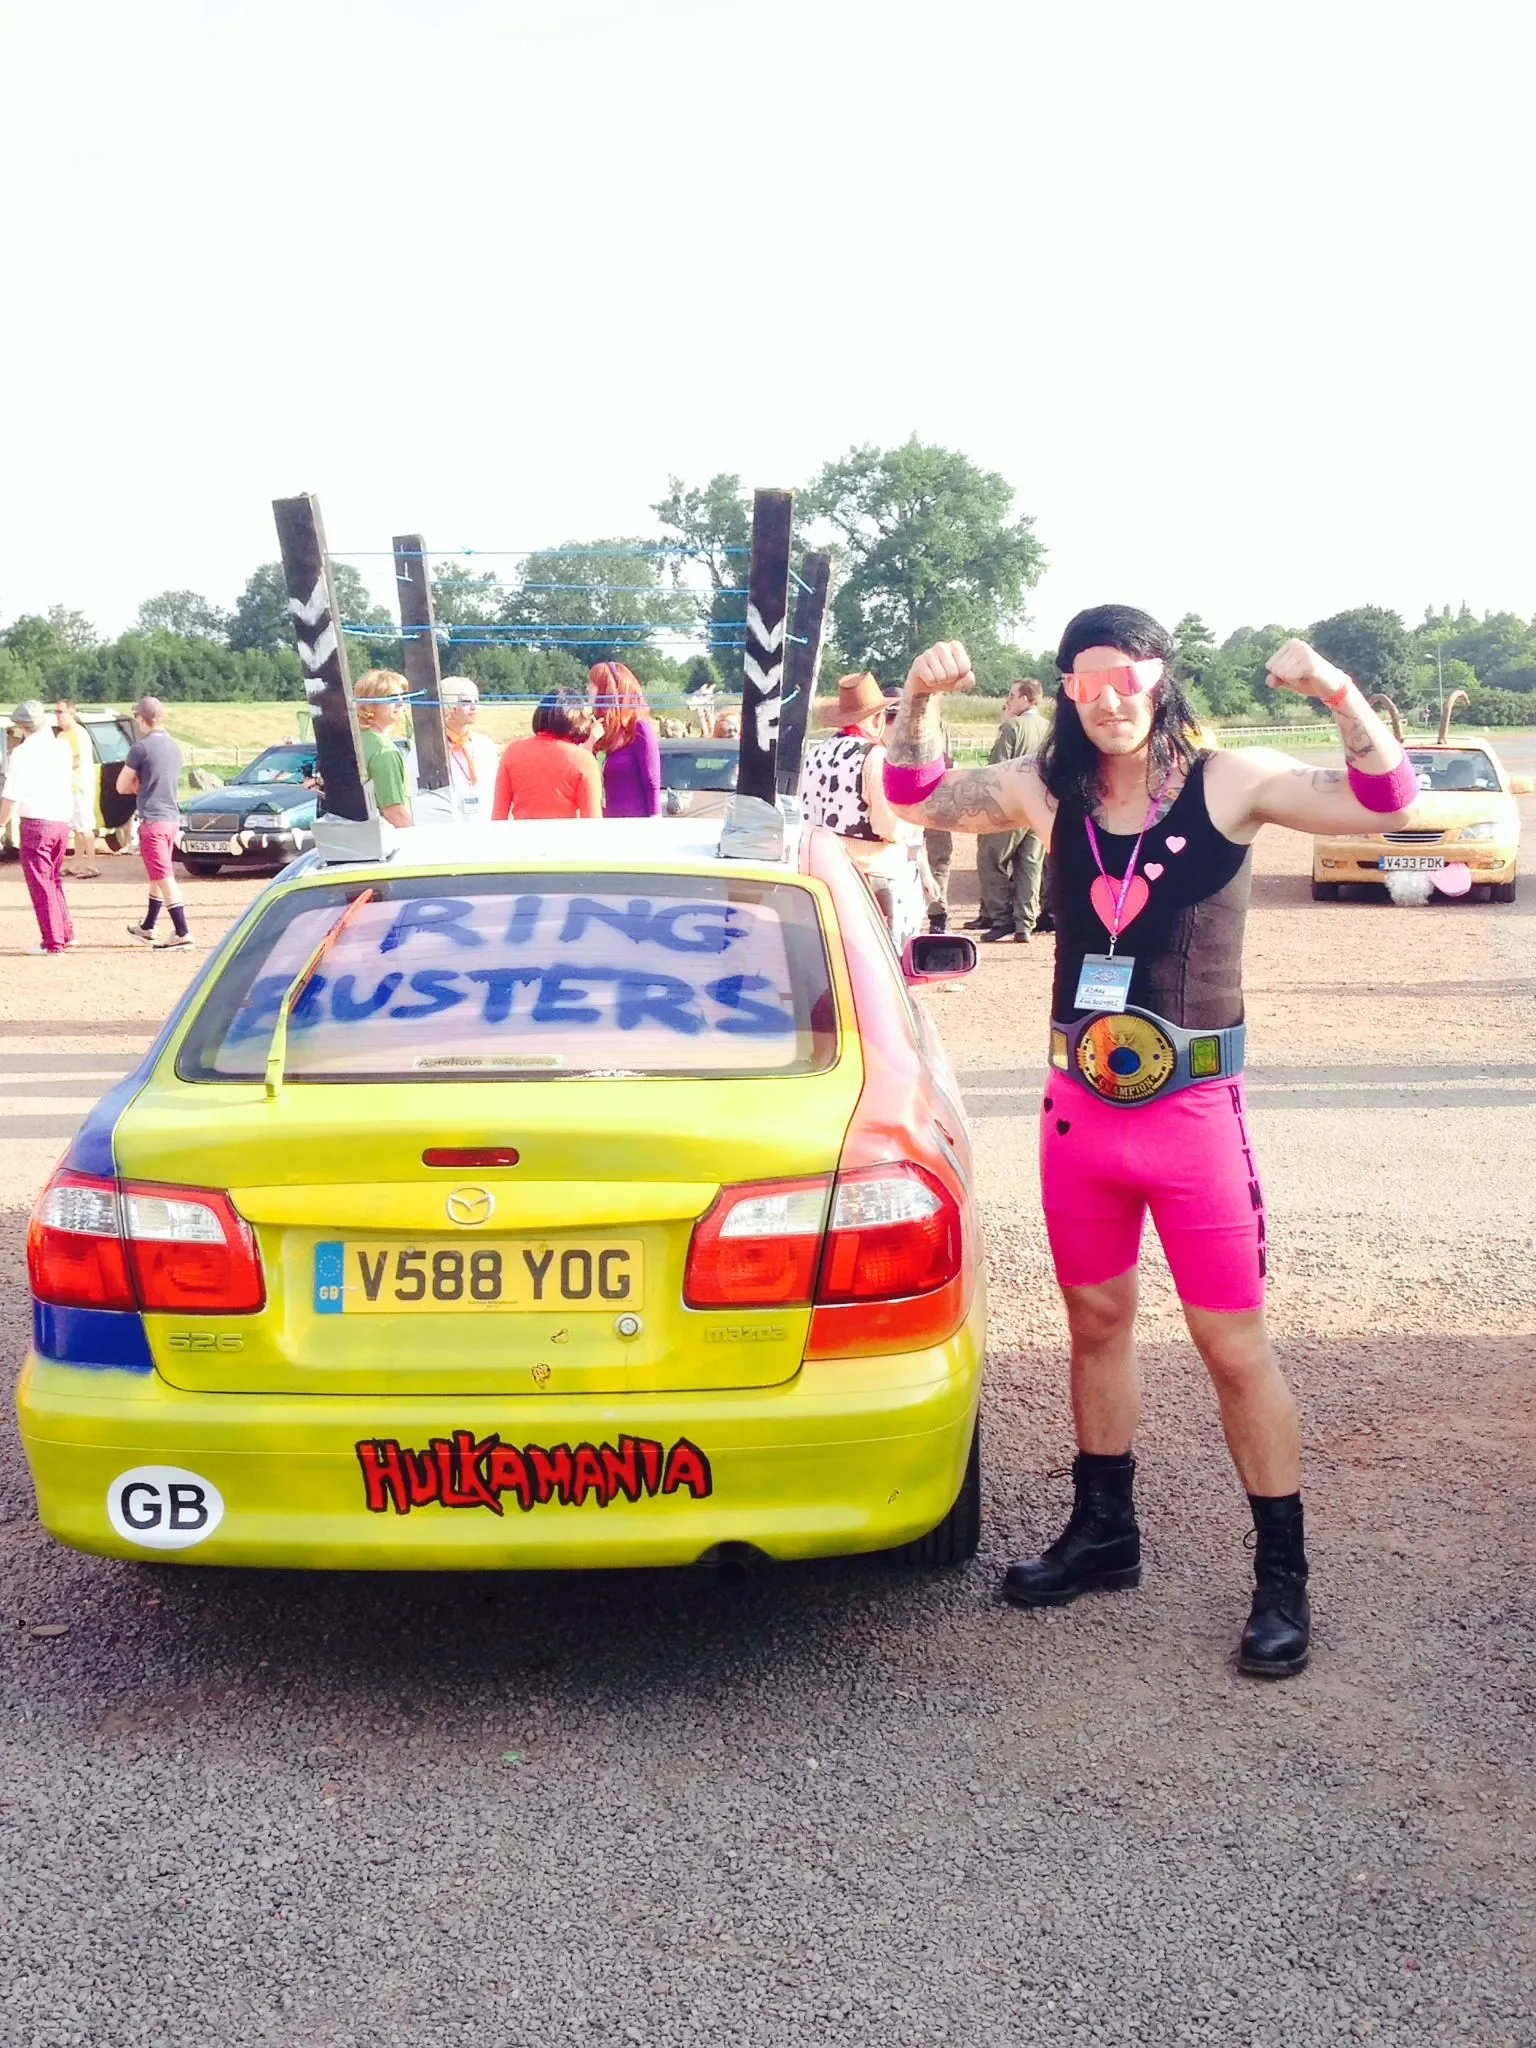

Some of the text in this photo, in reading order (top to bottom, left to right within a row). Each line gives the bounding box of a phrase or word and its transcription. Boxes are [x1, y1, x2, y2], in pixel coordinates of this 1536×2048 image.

[1386, 857, 1442, 869] V433 FDK
[380, 895, 750, 954] RING
[224, 963, 797, 1045] BUSTERS
[319, 1285, 340, 1301] GB
[357, 1249, 631, 1302] V588 YOG
[355, 1430, 713, 1517] HULKAMANIA
[120, 1482, 209, 1530] GB
